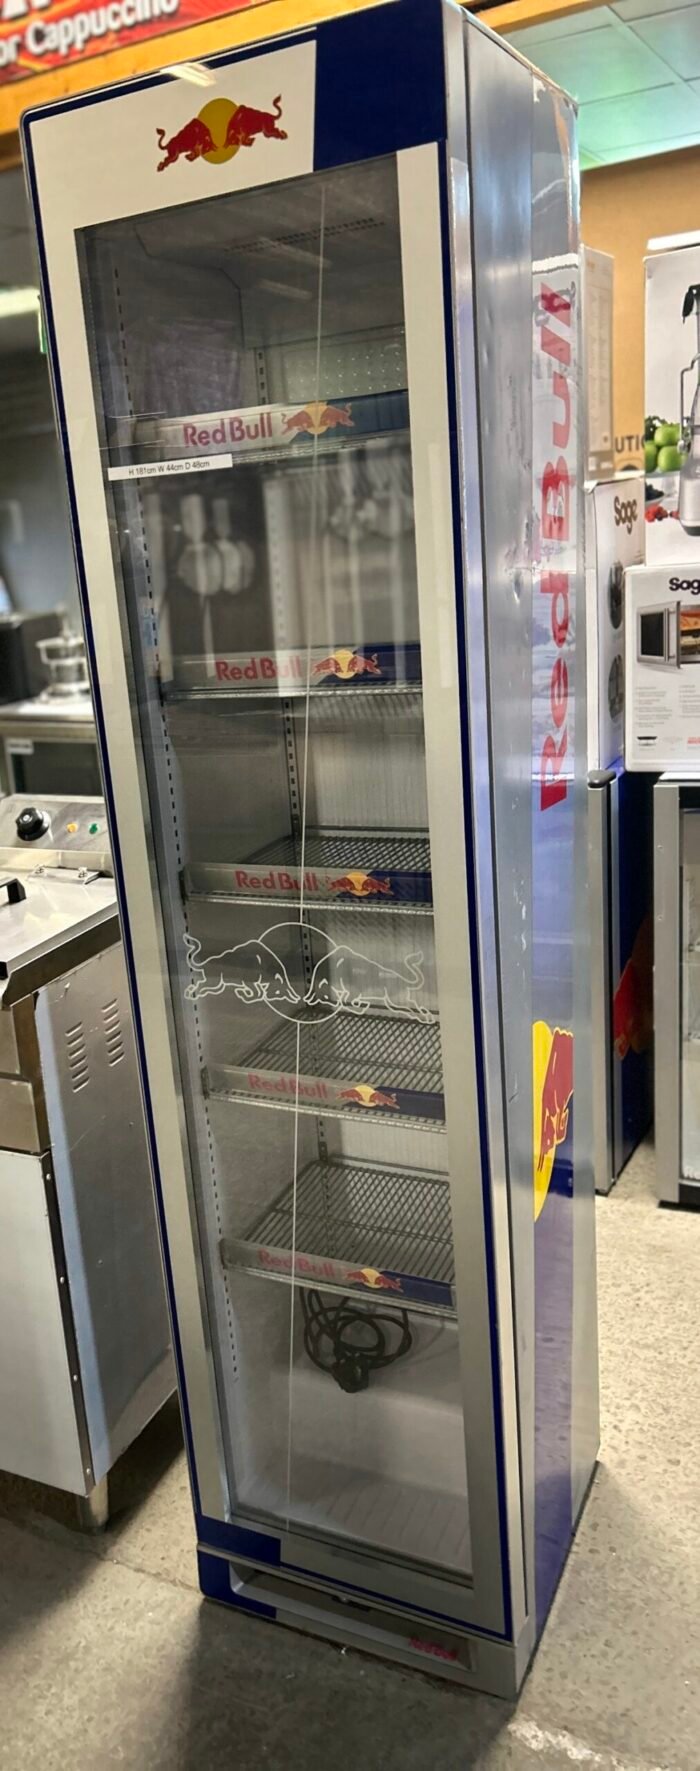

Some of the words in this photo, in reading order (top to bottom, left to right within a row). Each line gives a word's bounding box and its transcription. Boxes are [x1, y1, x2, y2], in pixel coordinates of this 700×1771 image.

[25, 0, 178, 55] Cappuccino
[183, 418, 225, 448] Red
[229, 413, 273, 442] Bull
[136, 467, 157, 475] 181cm
[192, 461, 210, 469] 48cm
[614, 496, 638, 534] Sage
[215, 657, 257, 681] Red
[259, 656, 302, 679] Bull
[540, 570, 570, 812] Red
[235, 870, 276, 889] Red
[278, 872, 319, 891] Bull
[248, 1072, 286, 1094] Red
[288, 1077, 328, 1099] Bull
[258, 1247, 293, 1268] Red
[296, 1256, 335, 1278] Bull
